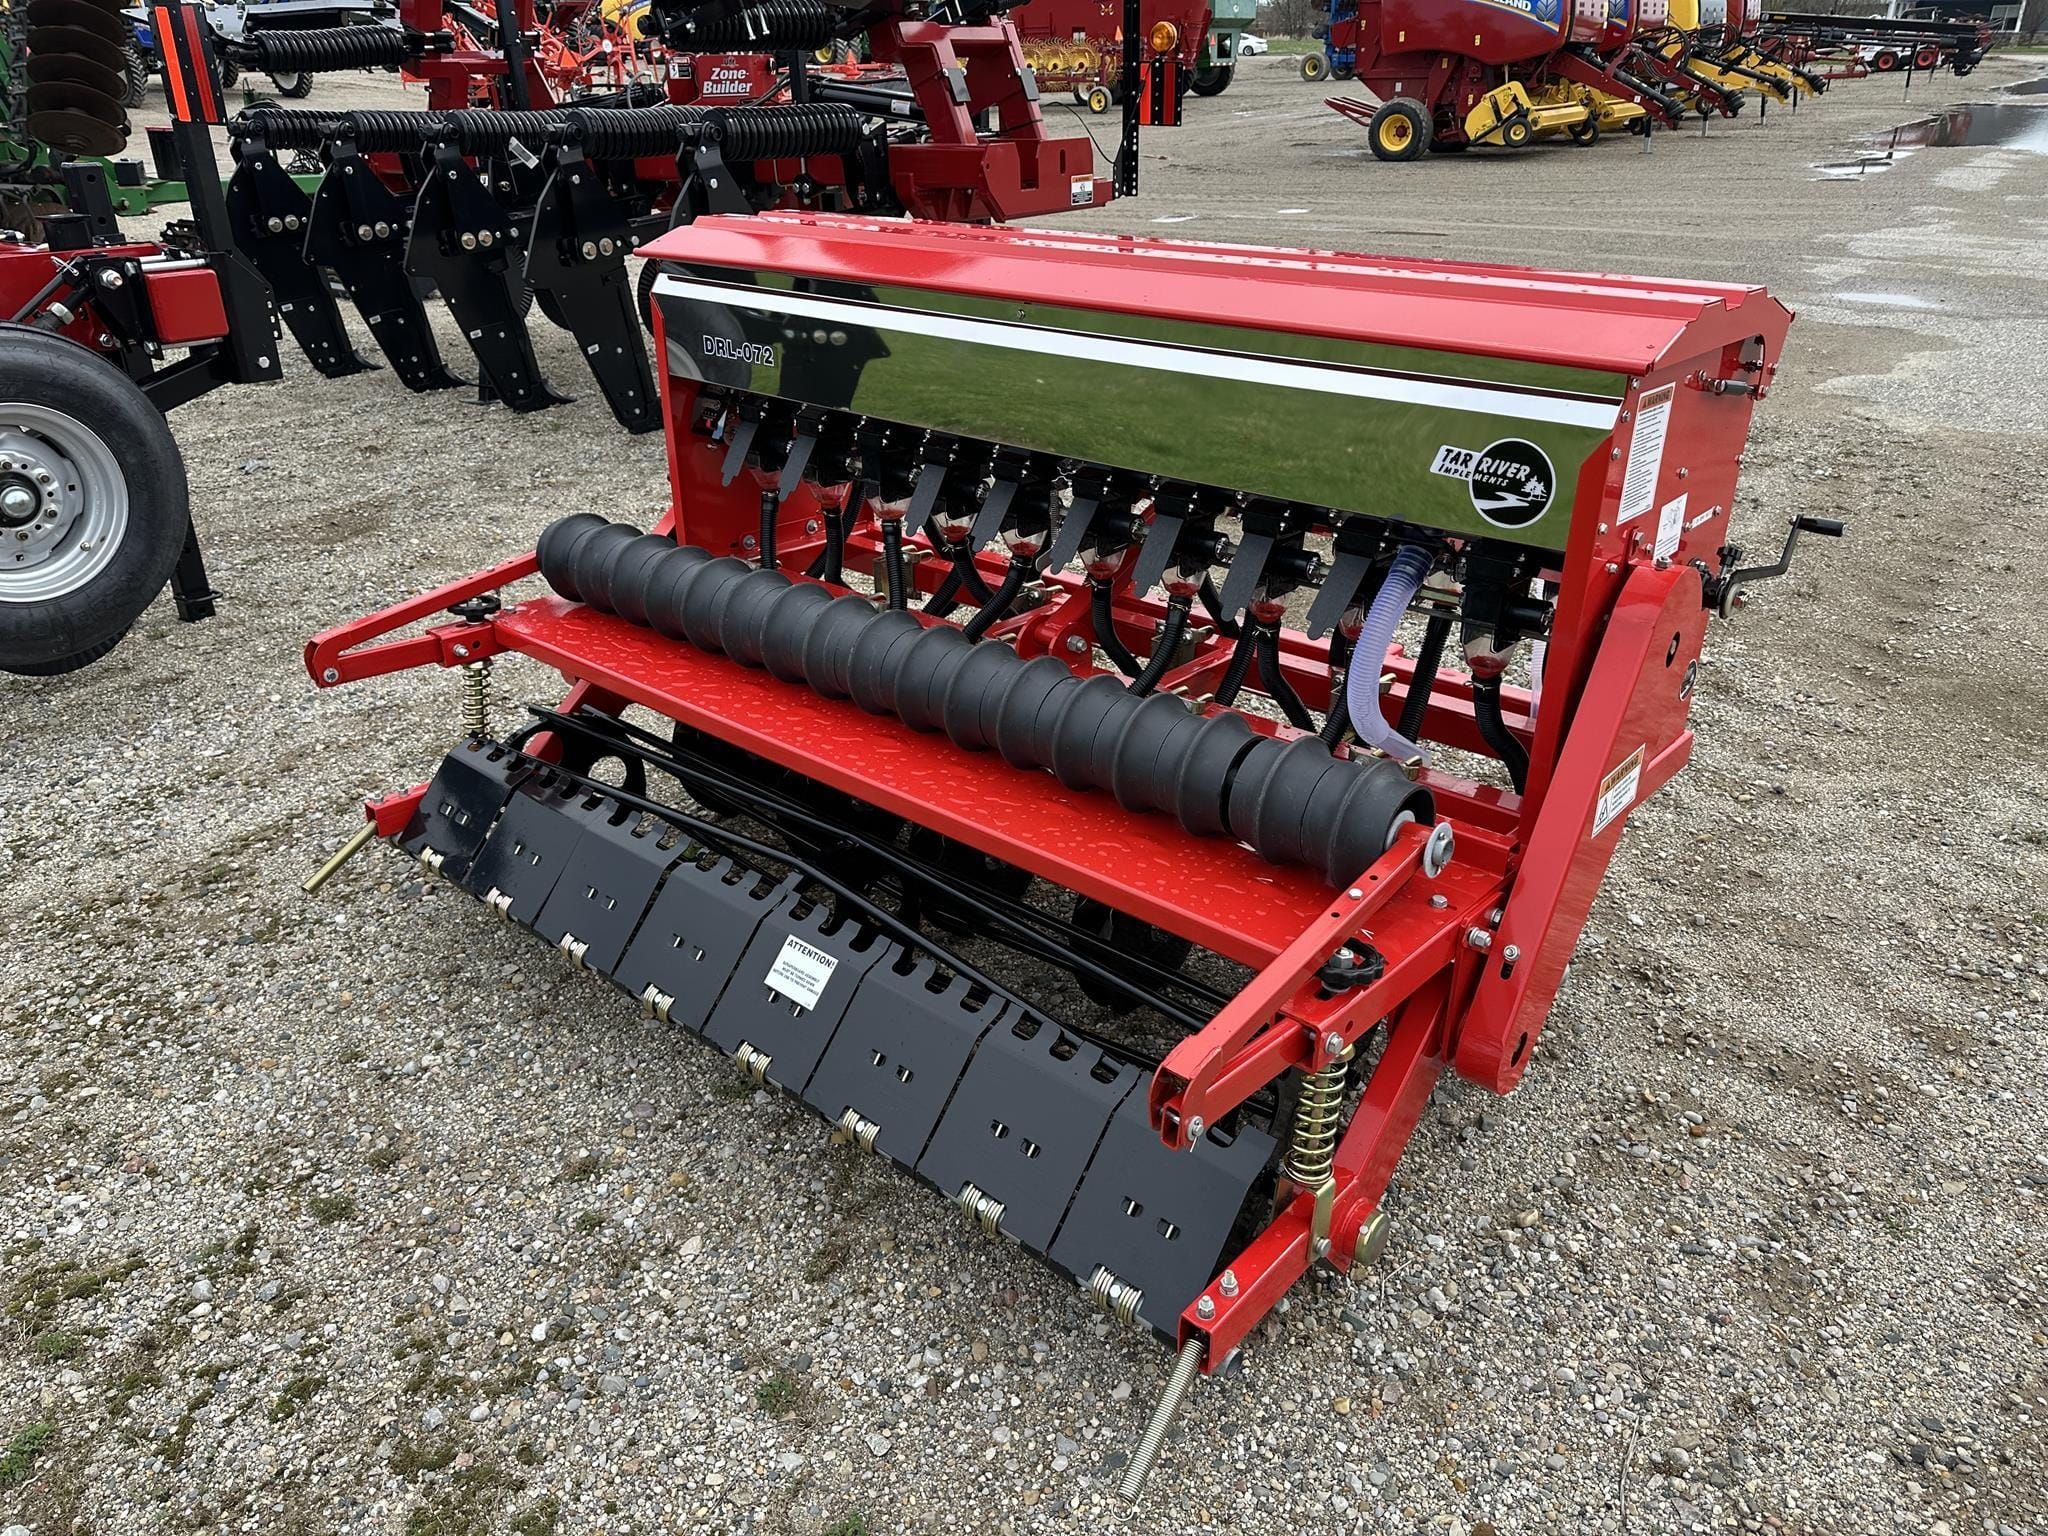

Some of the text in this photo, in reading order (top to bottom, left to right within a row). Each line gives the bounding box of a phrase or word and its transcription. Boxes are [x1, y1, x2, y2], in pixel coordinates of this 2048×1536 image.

[703, 81, 753, 94] Builder
[703, 335, 774, 366] DRL-072
[1441, 448, 1531, 482] TAR RIVER
[787, 939, 835, 969] ATTENTION!
